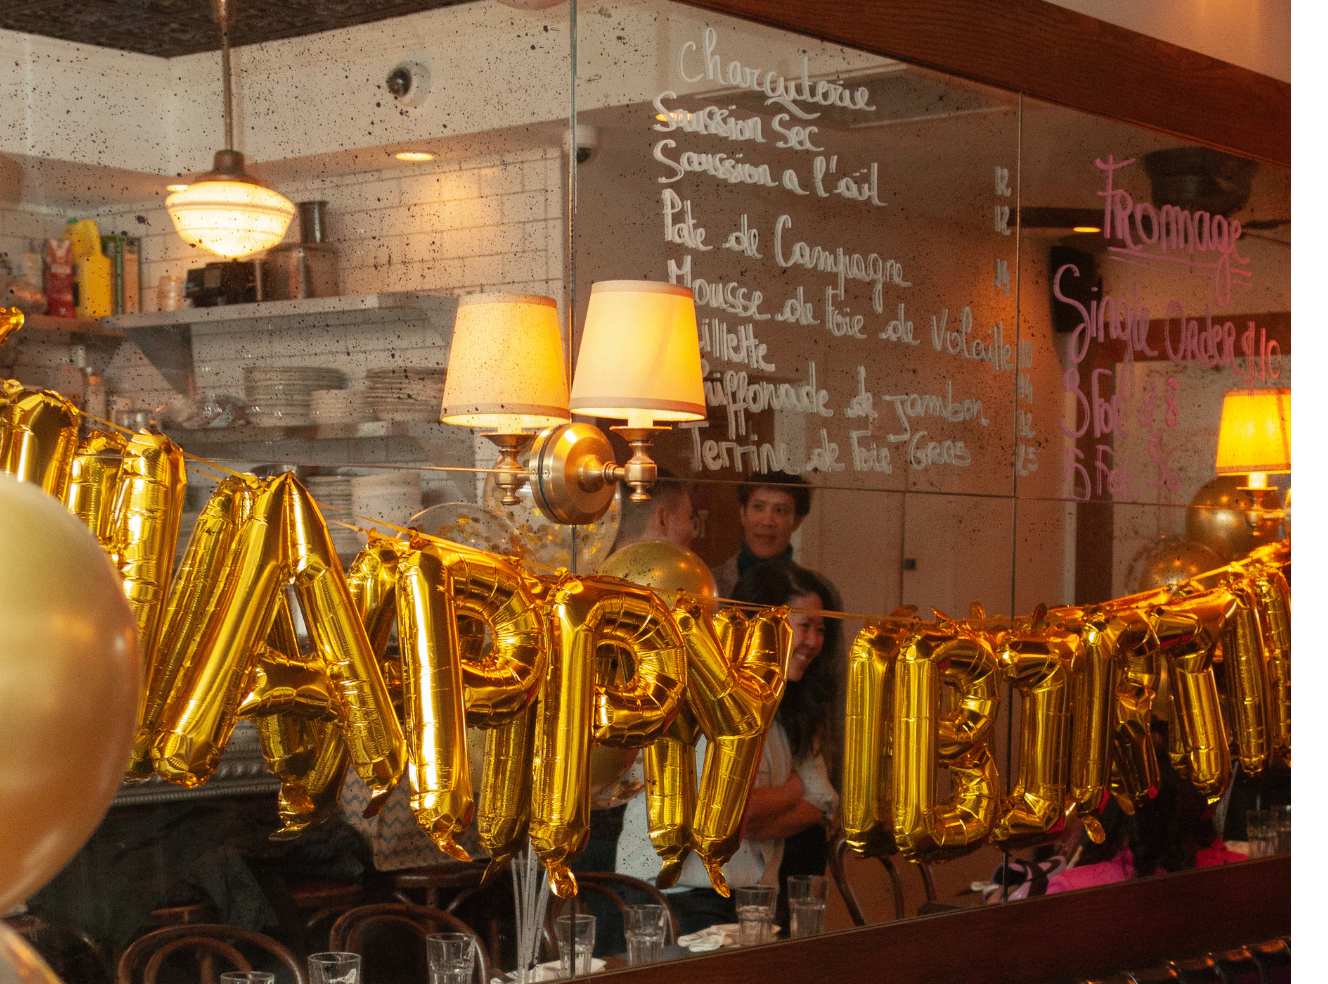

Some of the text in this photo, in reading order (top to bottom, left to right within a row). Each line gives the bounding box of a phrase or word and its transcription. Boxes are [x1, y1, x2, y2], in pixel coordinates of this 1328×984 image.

[771, 113, 825, 151] Sec
[722, 214, 762, 259] de
[775, 214, 912, 314] Campagne
[667, 255, 771, 320] Mousse
[775, 286, 820, 326] de
[879, 303, 921, 345] de
[930, 306, 1014, 371] Volaille
[699, 318, 775, 371] illette
[1053, 264, 1158, 402] Single
[1060, 368, 1090, 438] 3
[678, 421, 800, 475] Terrine
[806, 428, 845, 473] de
